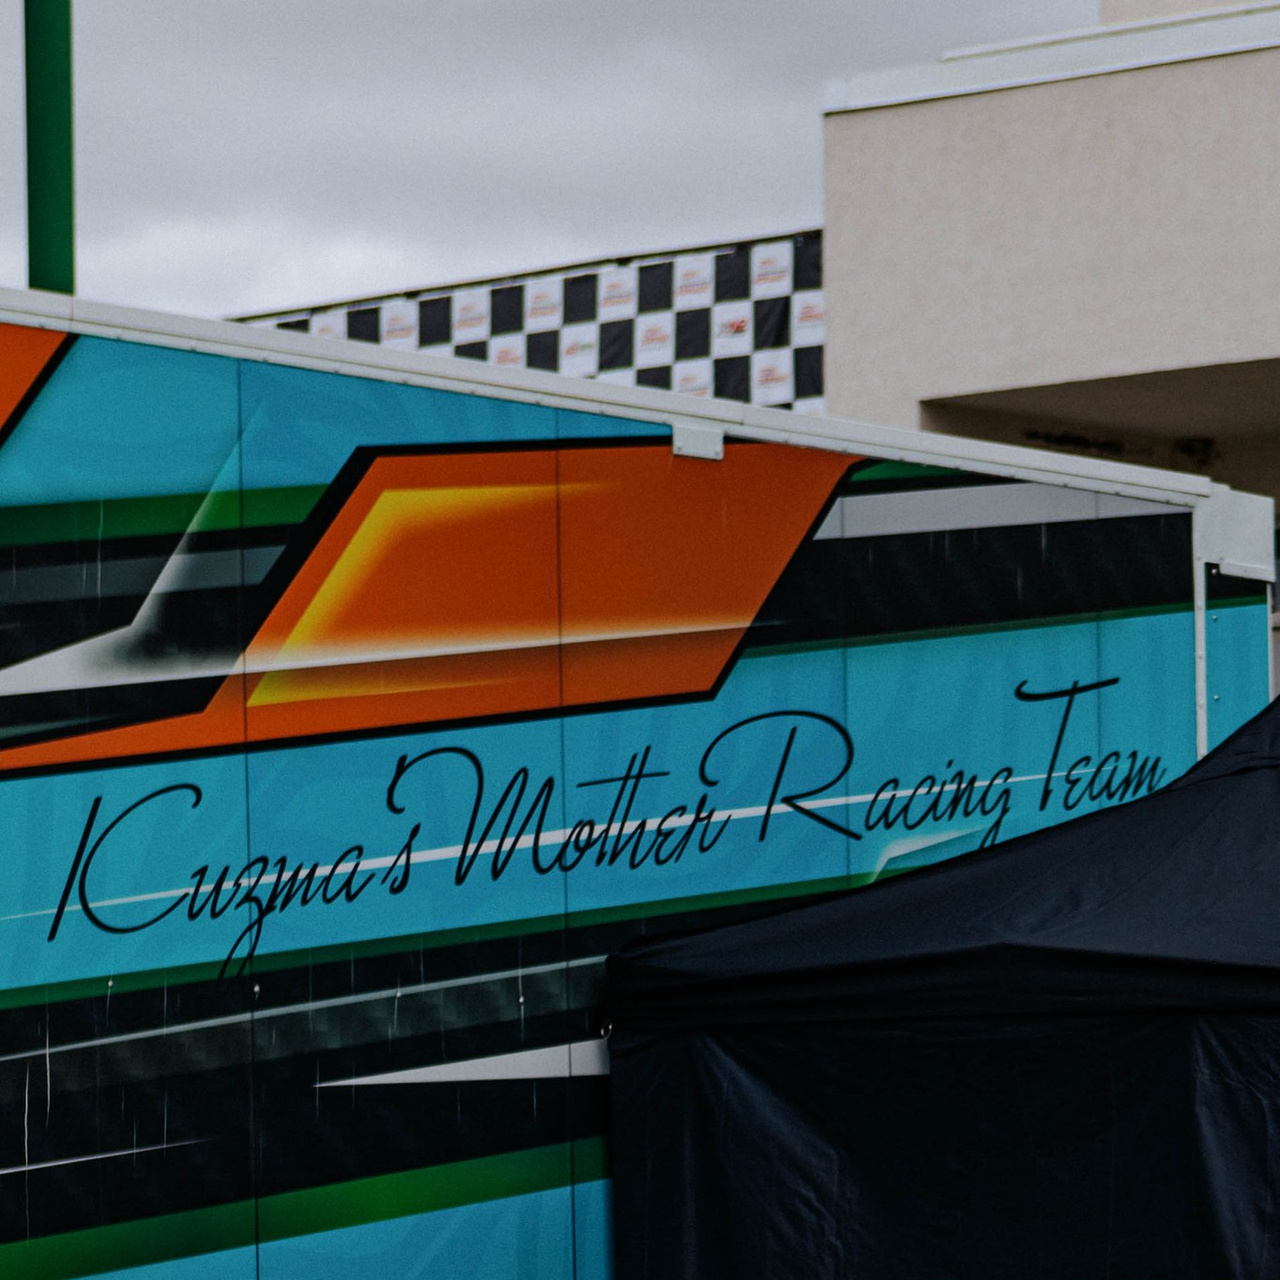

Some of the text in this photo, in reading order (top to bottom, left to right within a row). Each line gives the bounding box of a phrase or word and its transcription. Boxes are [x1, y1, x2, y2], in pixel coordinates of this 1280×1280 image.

[386, 744, 732, 886] Mother
[700, 710, 1011, 850] Racing
[1014, 677, 1167, 811] Team
